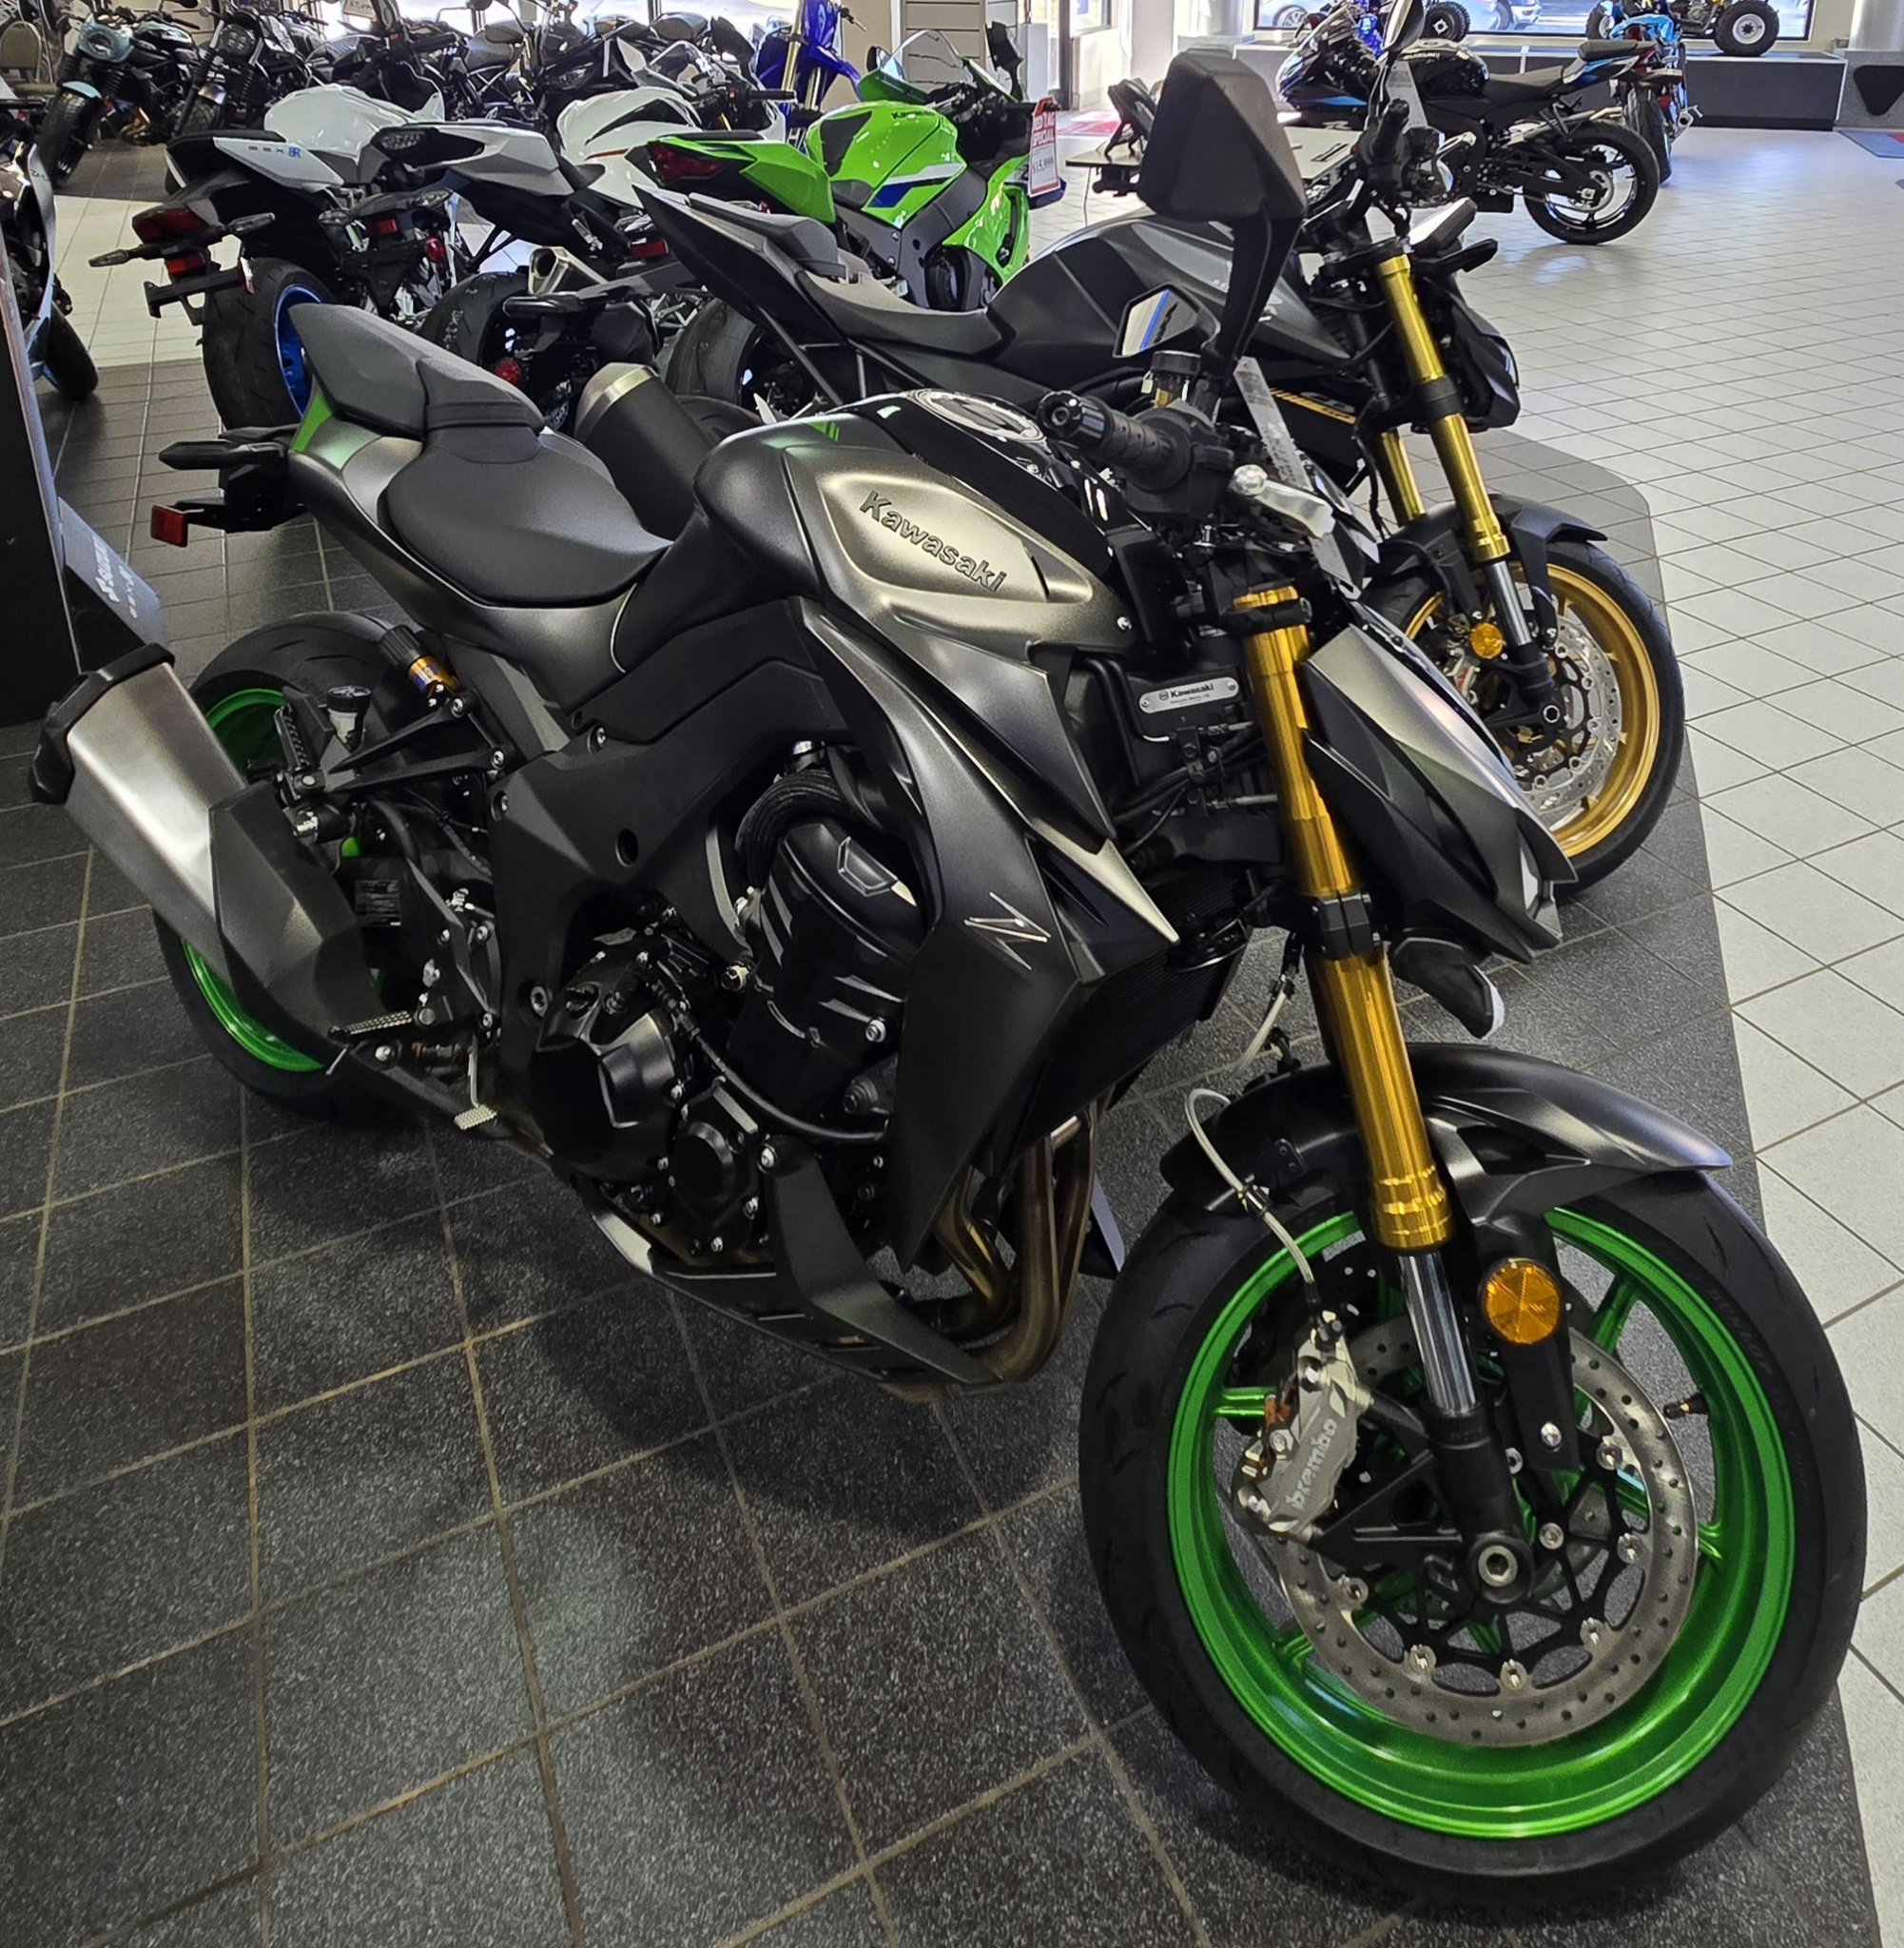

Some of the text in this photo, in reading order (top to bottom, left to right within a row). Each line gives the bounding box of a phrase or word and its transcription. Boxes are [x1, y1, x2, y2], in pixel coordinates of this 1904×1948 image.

[859, 490, 1008, 593] Kawasaki
[1170, 683, 1214, 698] Kawasaki
[1285, 1418, 1337, 1510] brembo
